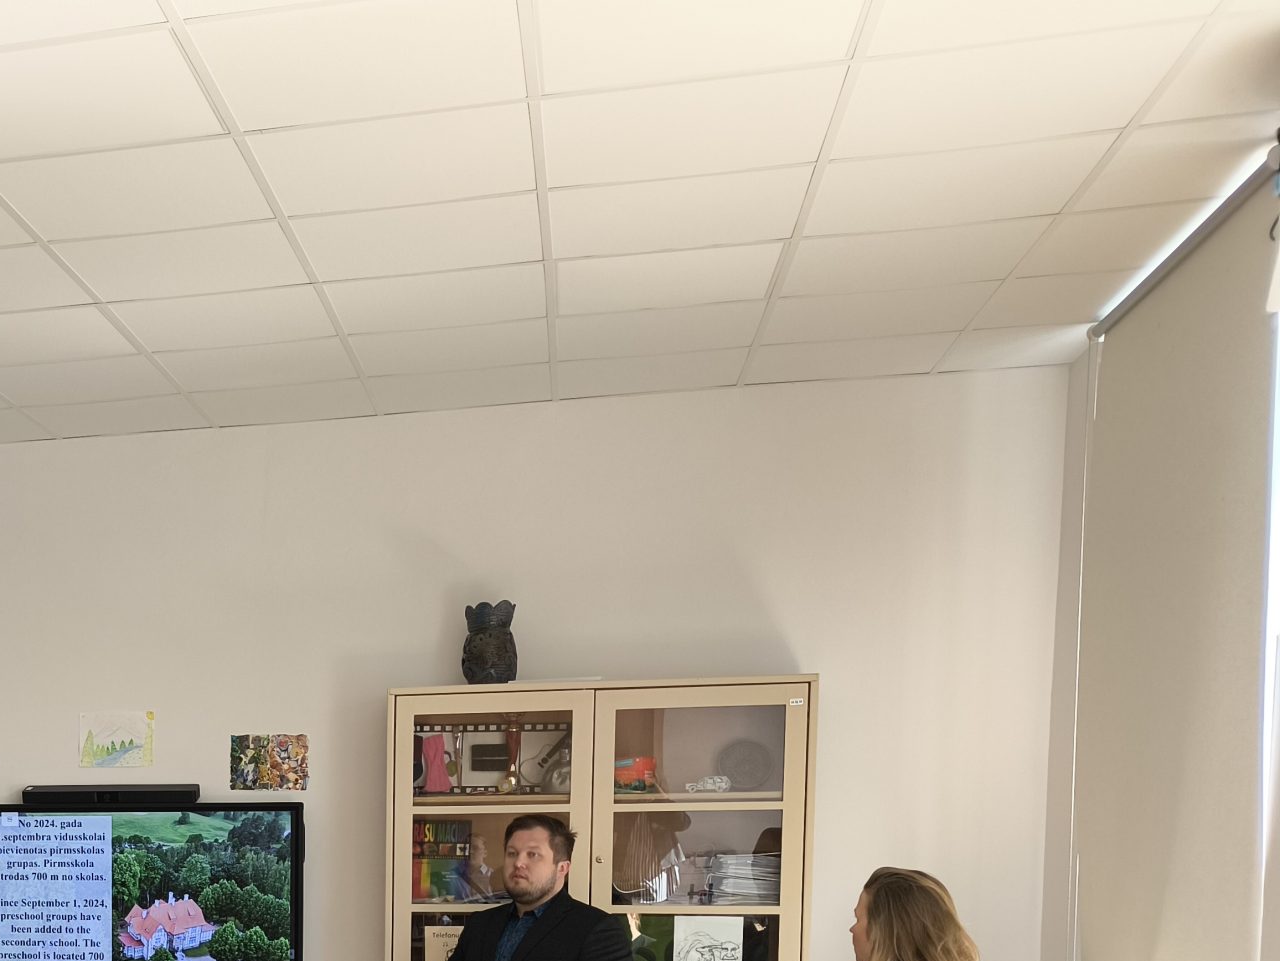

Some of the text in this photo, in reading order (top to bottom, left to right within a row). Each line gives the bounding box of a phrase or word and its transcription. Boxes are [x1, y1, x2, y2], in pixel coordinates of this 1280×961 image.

[19, 819, 82, 829] No 2024. gada
[54, 833, 105, 841] vidusskolai
[50, 846, 105, 856] pirmsskolas
[7, 859, 94, 869] grupas. Pirmsskola
[32, 872, 47, 881] 700
[76, 872, 106, 881] skolas.
[21, 899, 70, 909] September
[84, 899, 107, 908] 2024,
[0, 912, 101, 922] preschool groups have
[11, 925, 90, 934] been added to the
[1, 938, 101, 948] secondary school. The
[43, 952, 50, 960] is
[53, 952, 85, 960] located
[88, 952, 104, 960] 700
